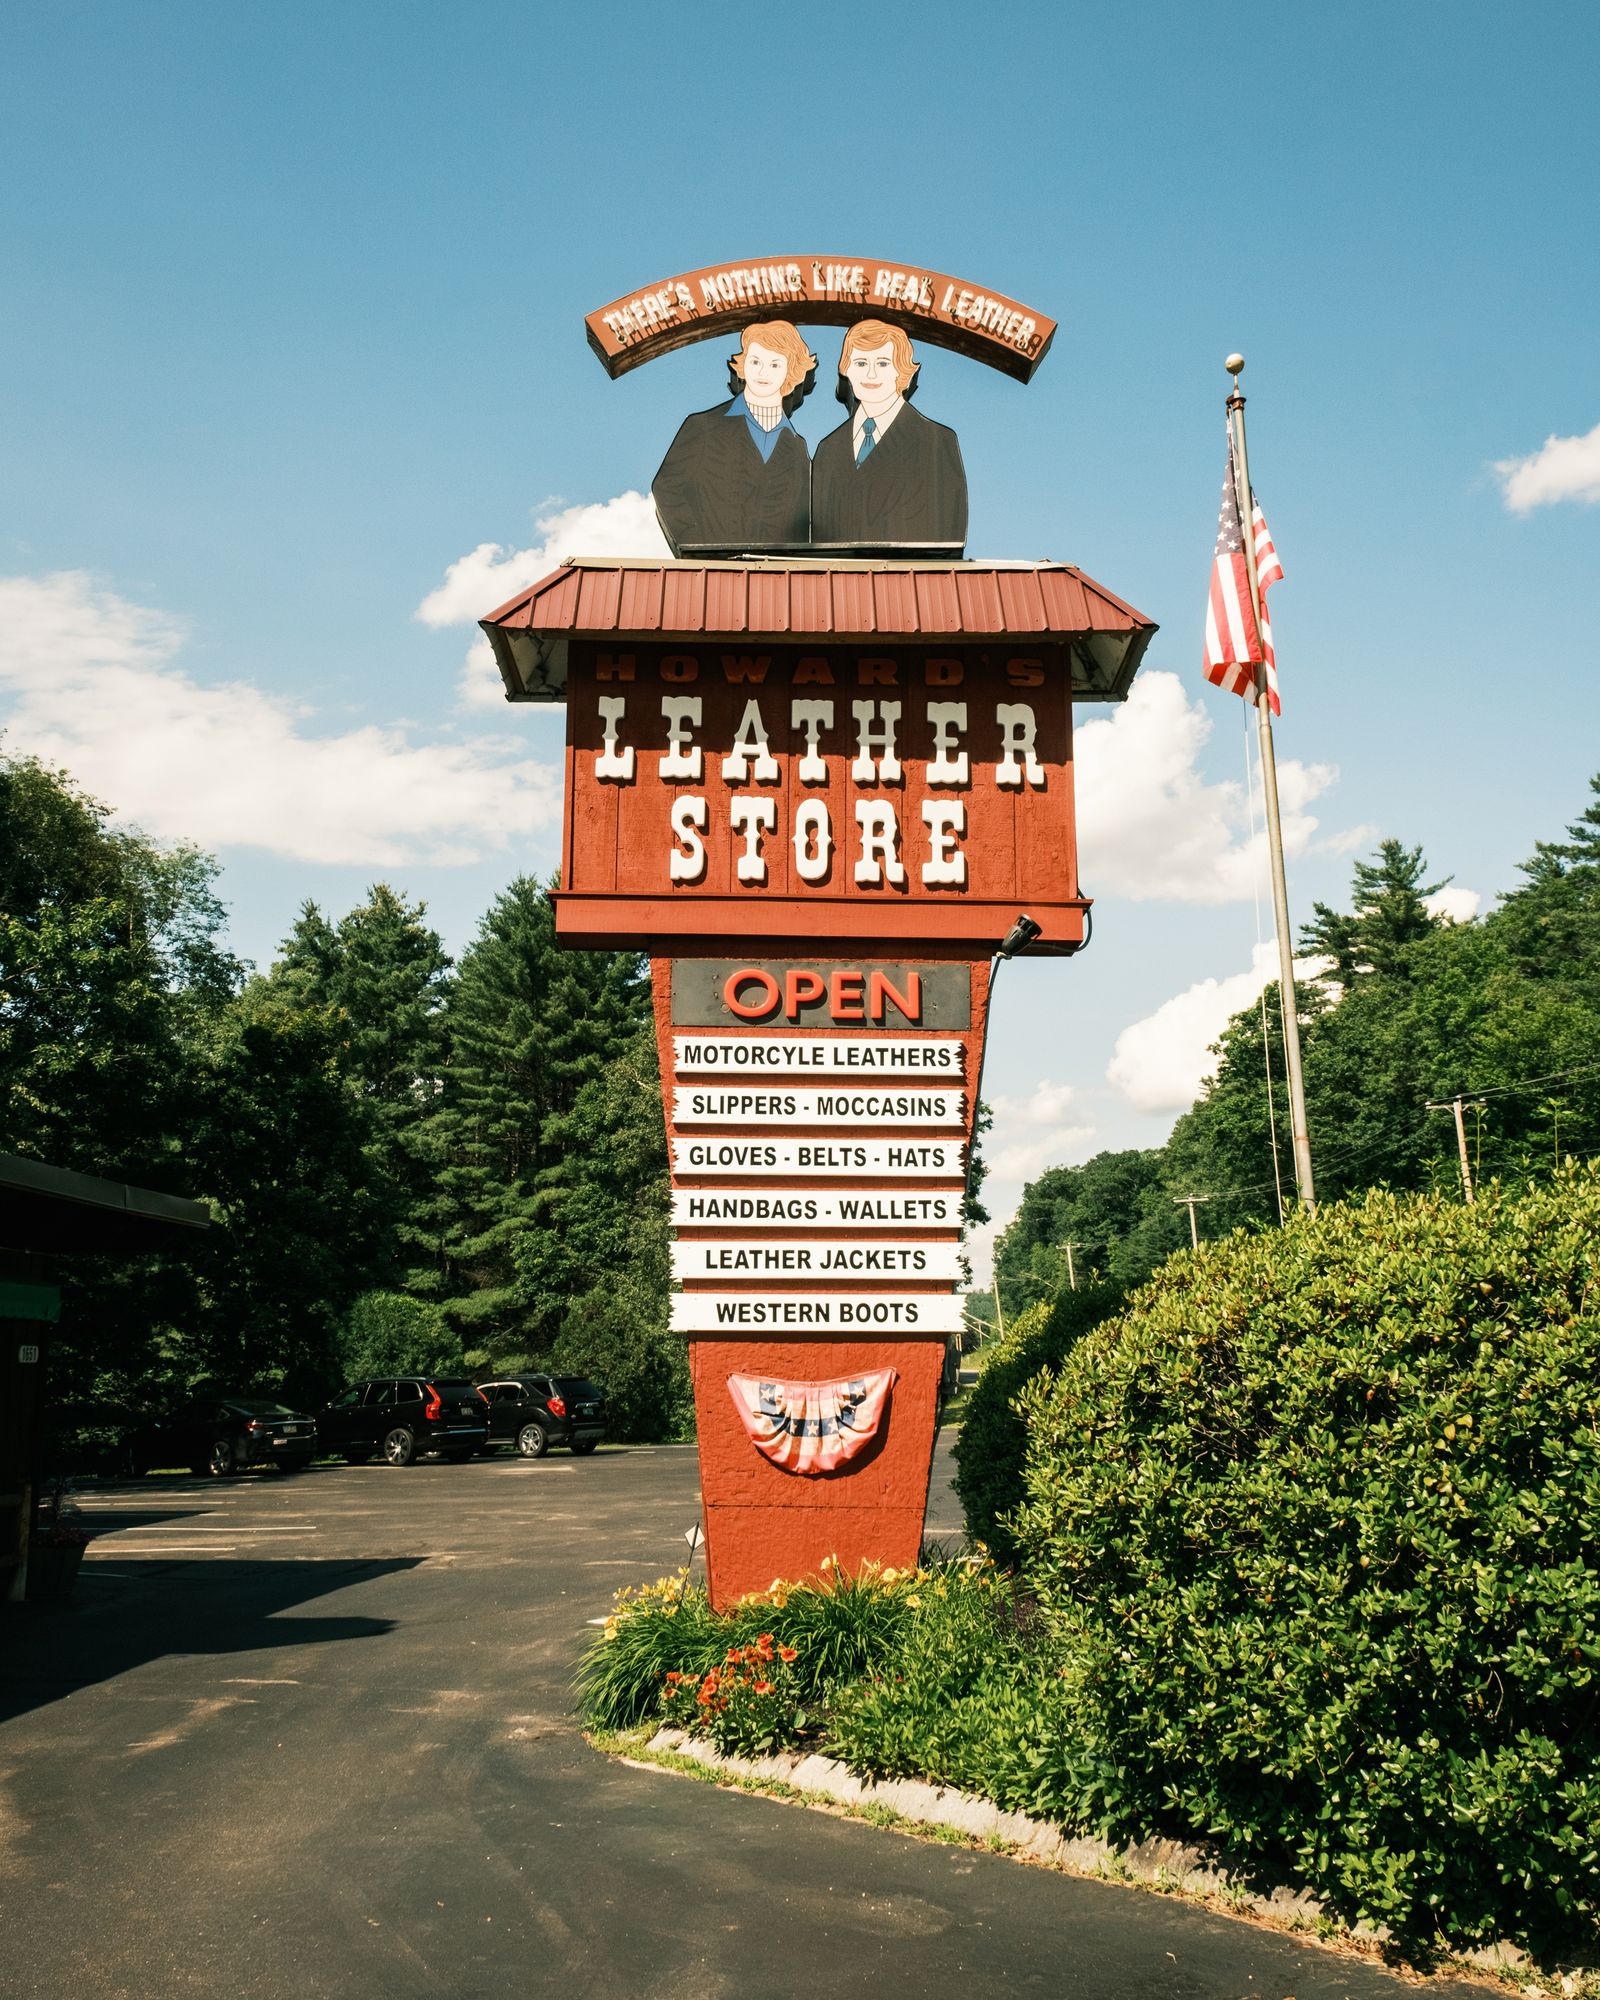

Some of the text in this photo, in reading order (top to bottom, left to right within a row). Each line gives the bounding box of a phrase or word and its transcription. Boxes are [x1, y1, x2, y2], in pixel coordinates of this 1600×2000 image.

[602, 260, 1036, 350] THERE'S NOTHING LIKE REAL LEATHER
[595, 654, 1046, 688] HOWARD'S
[595, 696, 1045, 785] LEATHER
[670, 796, 965, 884] STORE
[724, 968, 920, 1019] OPEN
[685, 1046, 950, 1066] MOTORCYLE LEATHERS
[693, 1095, 795, 1115] SLIPPERS
[818, 1097, 945, 1116] MOCCASINS
[690, 1146, 776, 1166] GLOVES
[799, 1148, 866, 1166] BELTS
[889, 1148, 944, 1167] HATS
[690, 1199, 817, 1219] HANDBAGS
[840, 1200, 946, 1219] WALLETS
[707, 1250, 925, 1269] LEATHER JACKETS
[717, 1303, 918, 1322] WESTERN BOOTS
